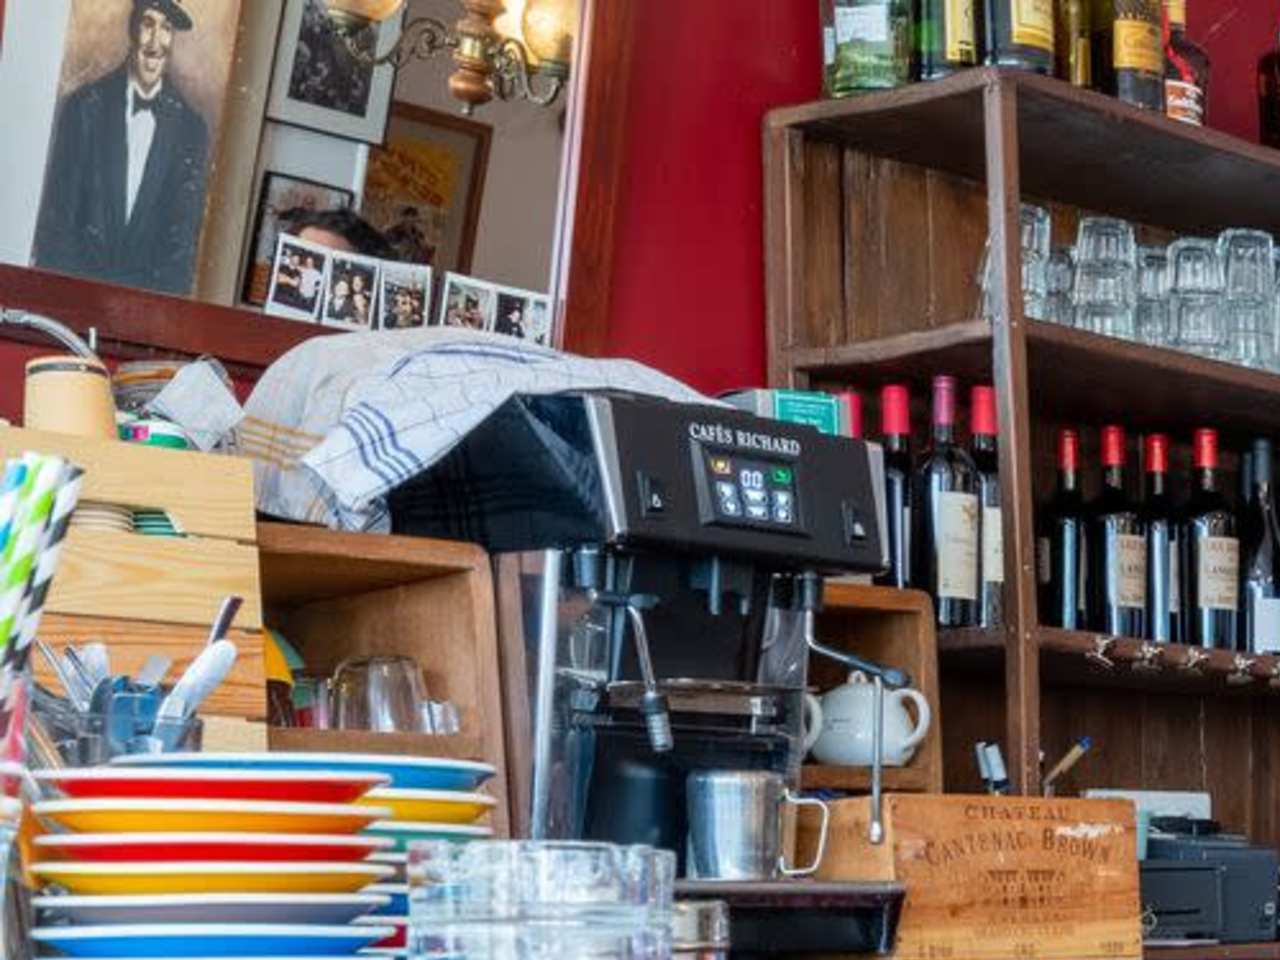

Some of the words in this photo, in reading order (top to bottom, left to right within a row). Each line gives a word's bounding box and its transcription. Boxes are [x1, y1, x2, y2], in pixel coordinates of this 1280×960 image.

[736, 429, 801, 456] RICHARD
[965, 804, 1071, 821] CHATEAU
[924, 829, 1029, 866] CANTENAC
